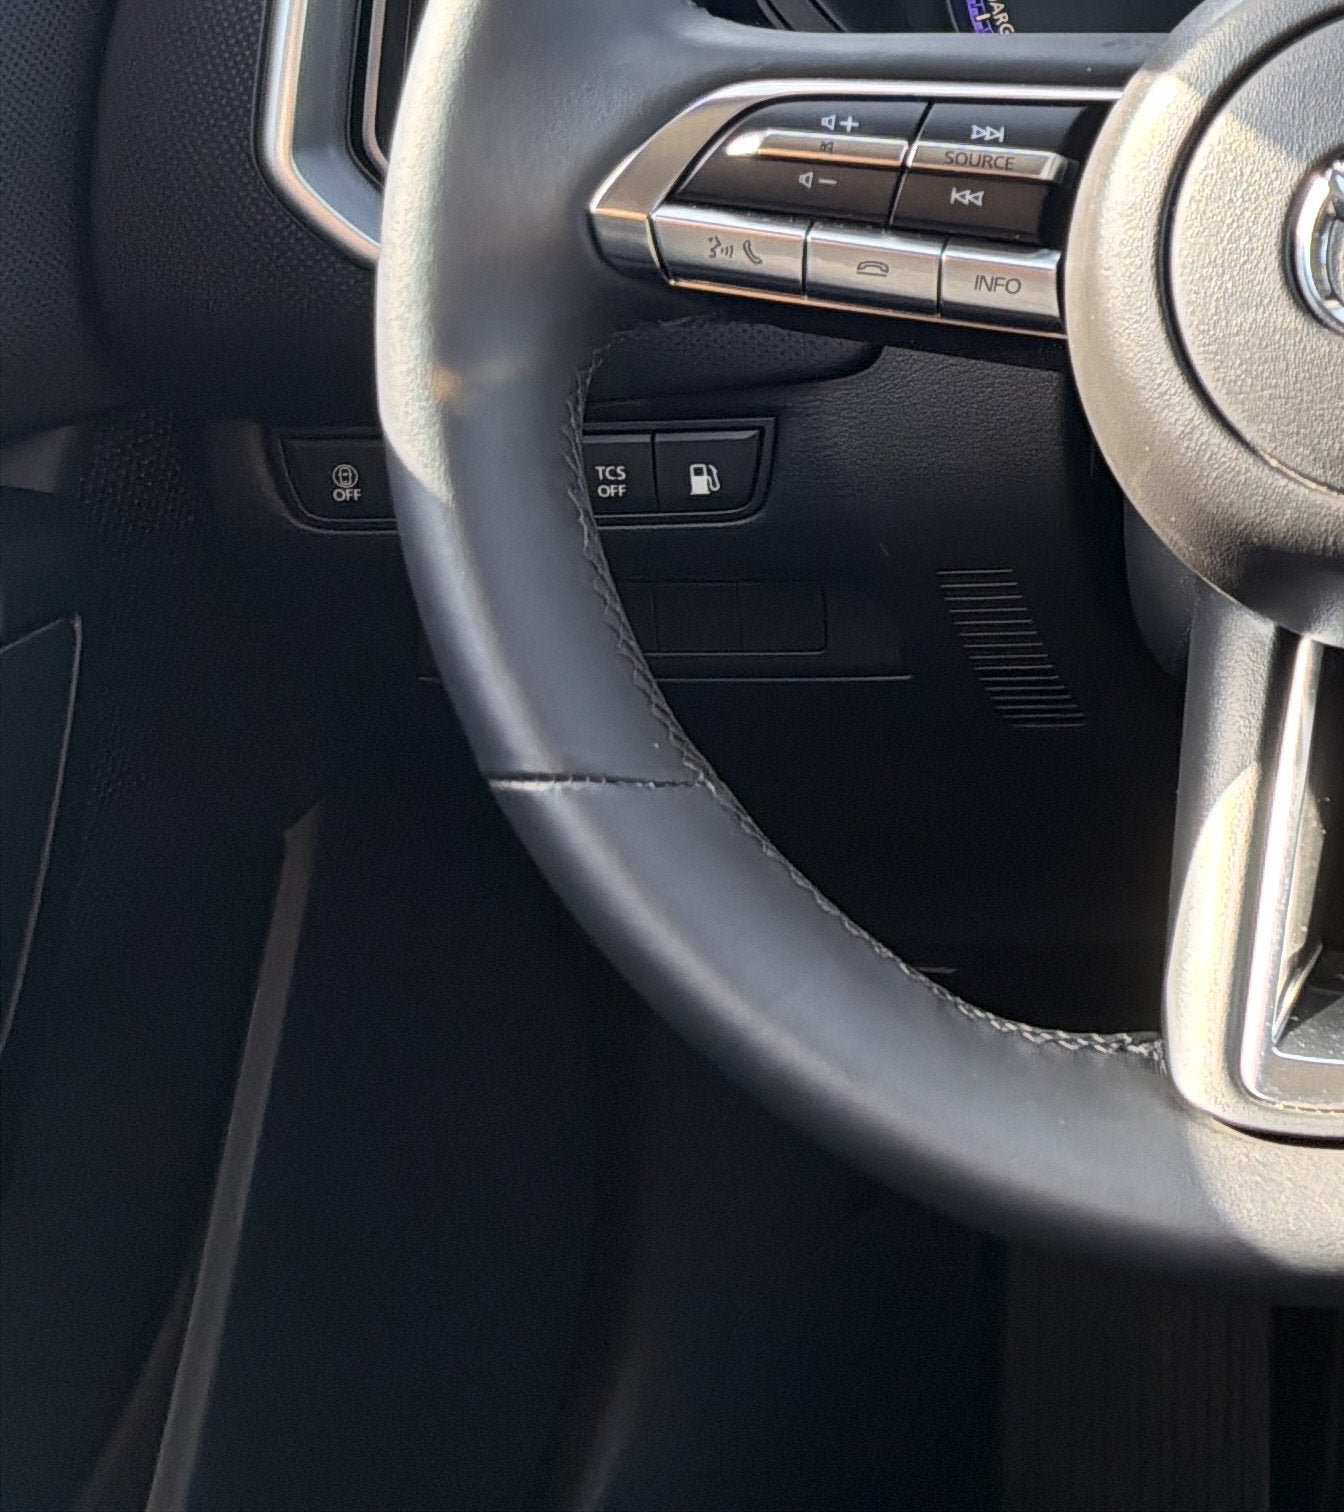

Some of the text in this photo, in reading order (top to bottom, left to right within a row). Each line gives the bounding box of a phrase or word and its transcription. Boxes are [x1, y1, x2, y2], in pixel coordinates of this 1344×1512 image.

[944, 150, 1016, 171] SOURCE
[974, 273, 1022, 295] INFO
[595, 465, 627, 481] TCS
[332, 487, 362, 502] OFF
[597, 484, 627, 498] OFF
